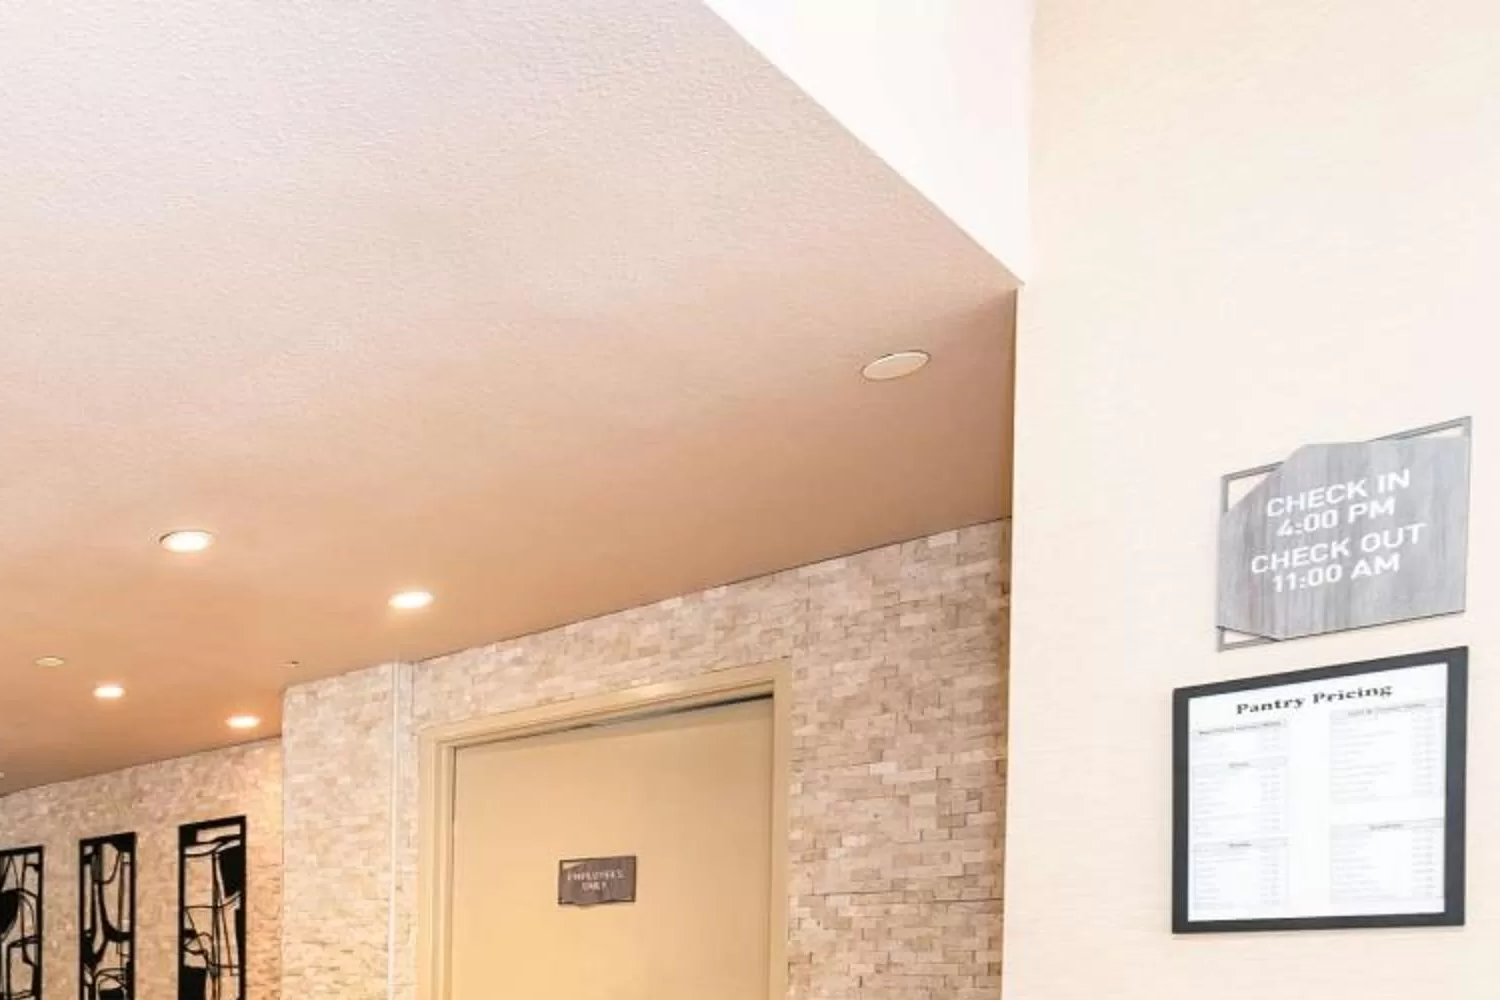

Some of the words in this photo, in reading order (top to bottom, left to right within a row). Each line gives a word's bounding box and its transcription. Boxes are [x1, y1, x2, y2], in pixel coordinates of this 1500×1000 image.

[1266, 479, 1367, 518] CHECK
[1377, 468, 1410, 494] IN
[1276, 508, 1338, 537] 4:00
[1348, 497, 1396, 525] PM
[1251, 537, 1351, 574] CHECK
[1361, 522, 1428, 553] OUT
[1271, 563, 1342, 593] 11:00
[1350, 553, 1400, 580] AM
[1236, 698, 1306, 715] Pantry
[1312, 685, 1394, 704] Pricing
